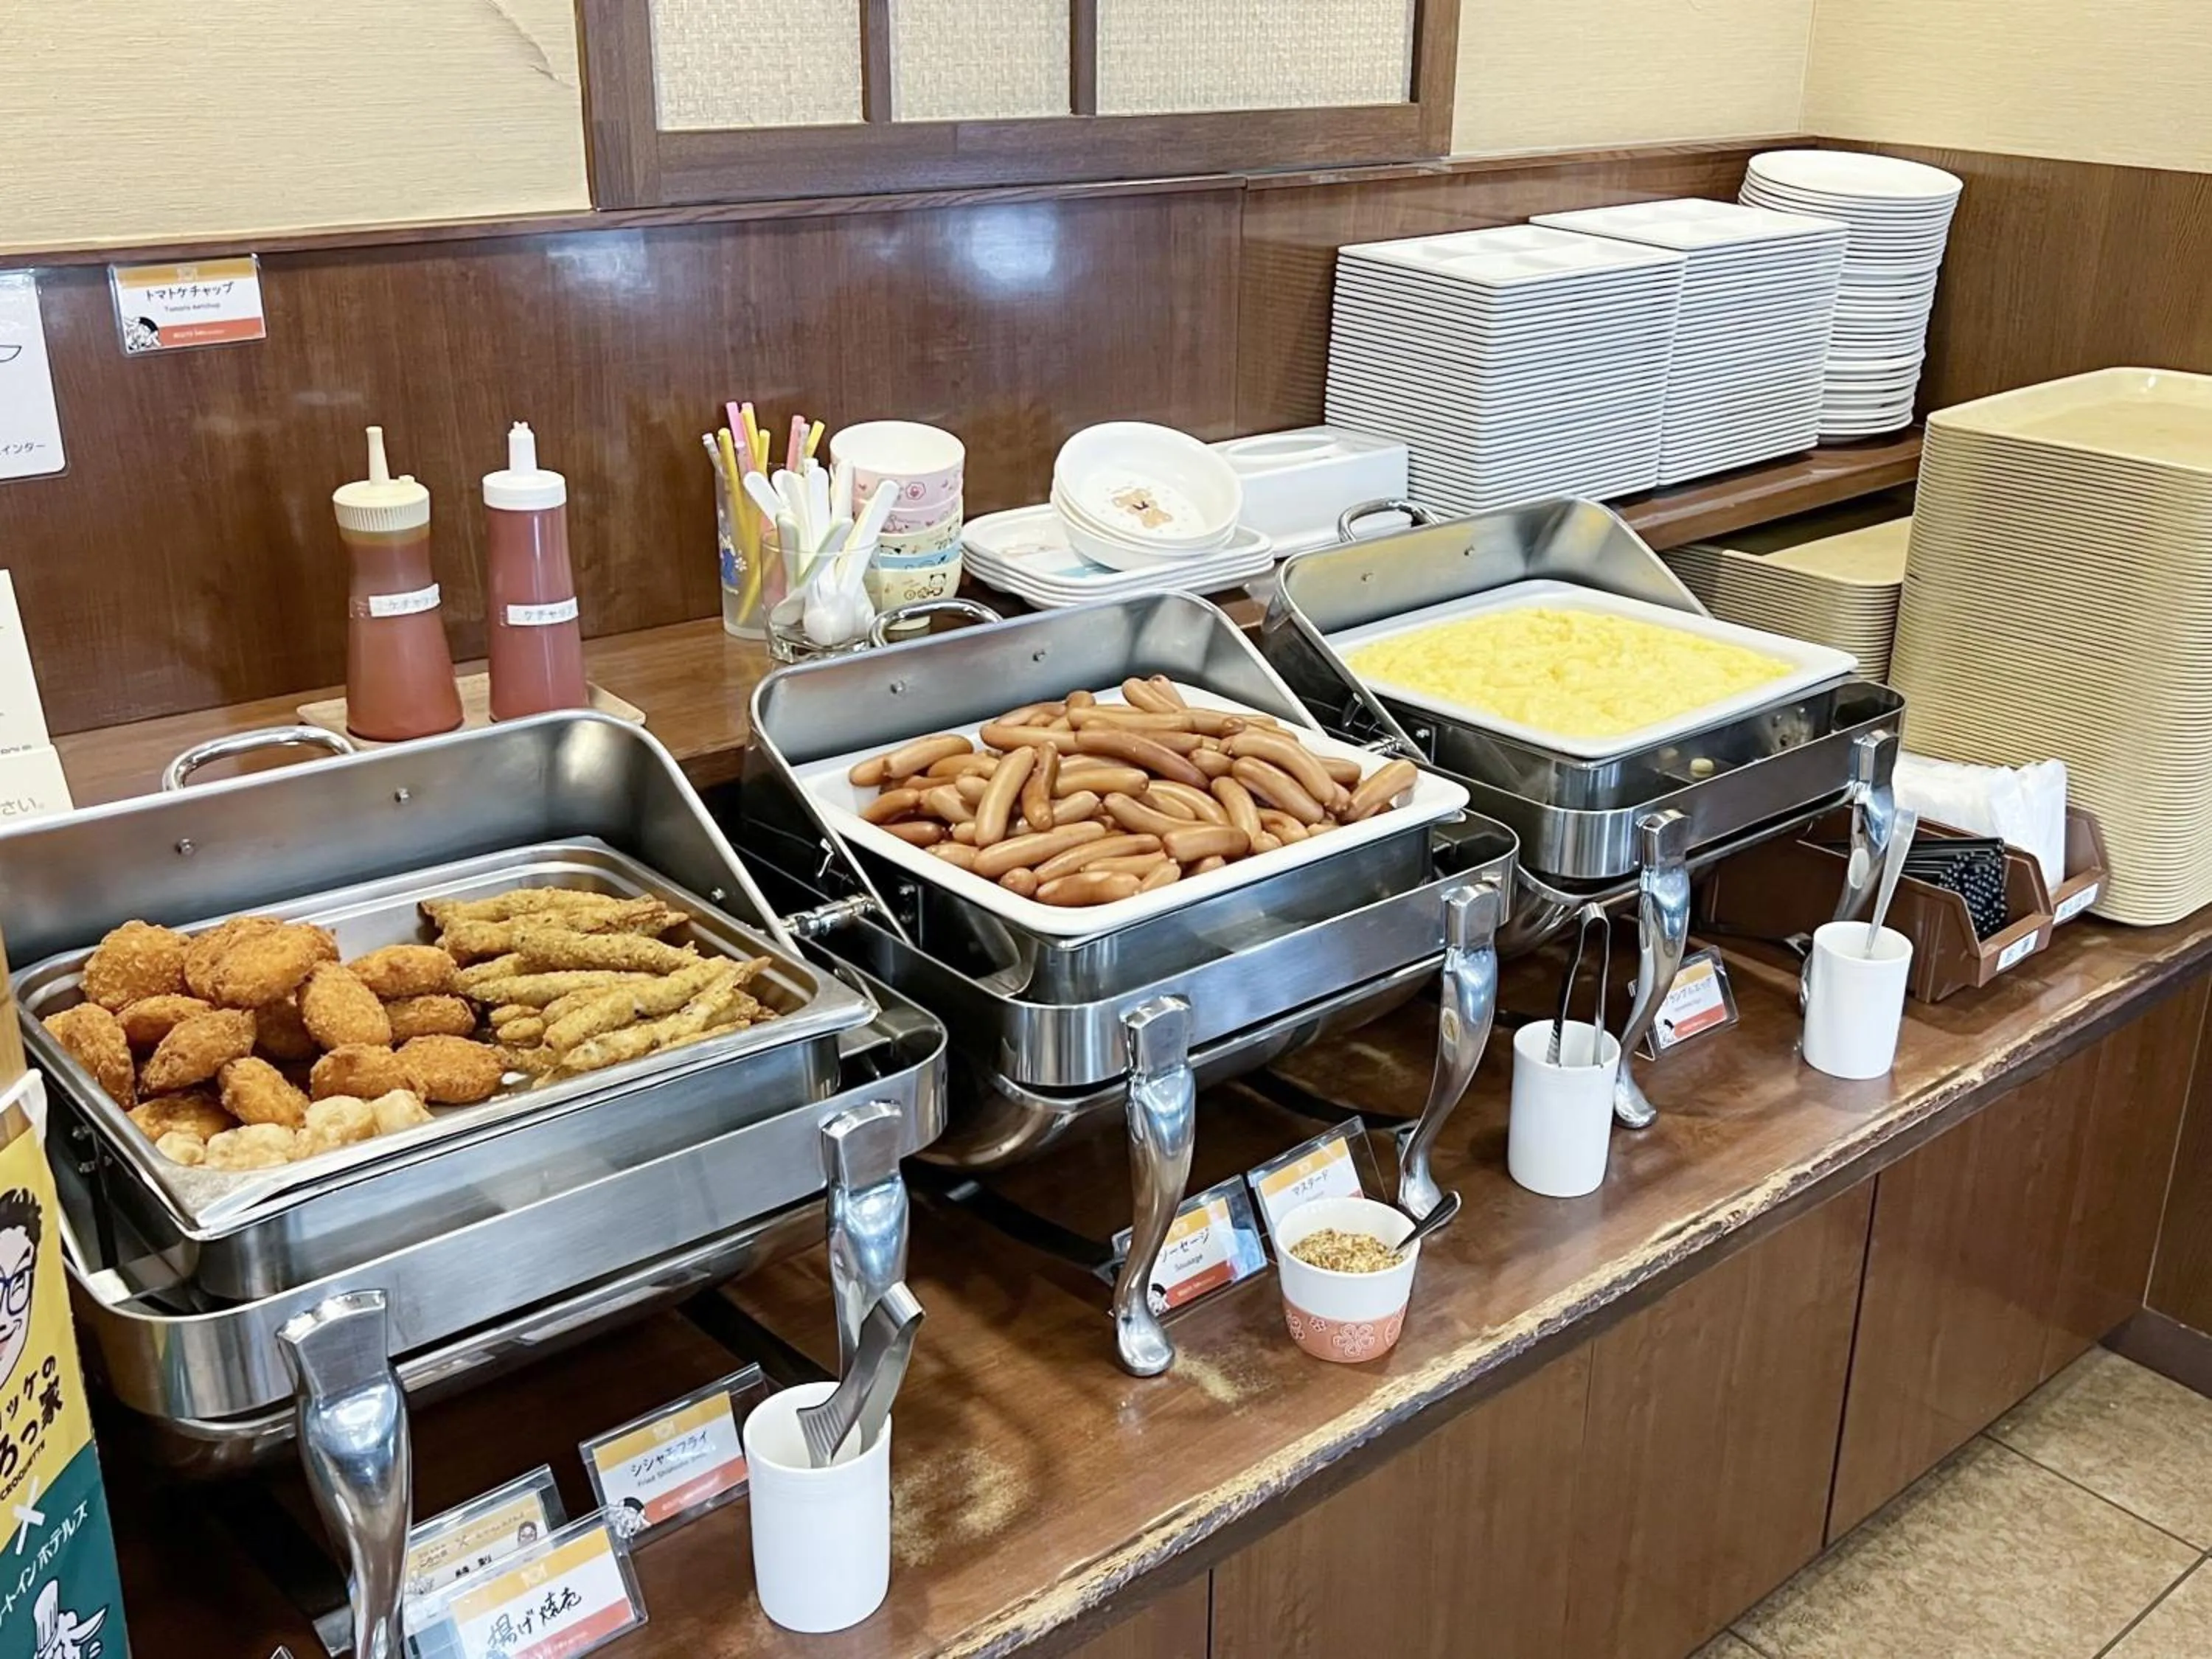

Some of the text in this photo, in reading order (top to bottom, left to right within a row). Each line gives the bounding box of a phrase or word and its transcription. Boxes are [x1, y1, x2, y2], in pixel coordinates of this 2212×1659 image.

[146, 281, 234, 302] トマトケチャップ
[0, 1354, 56, 1432] ッケの
